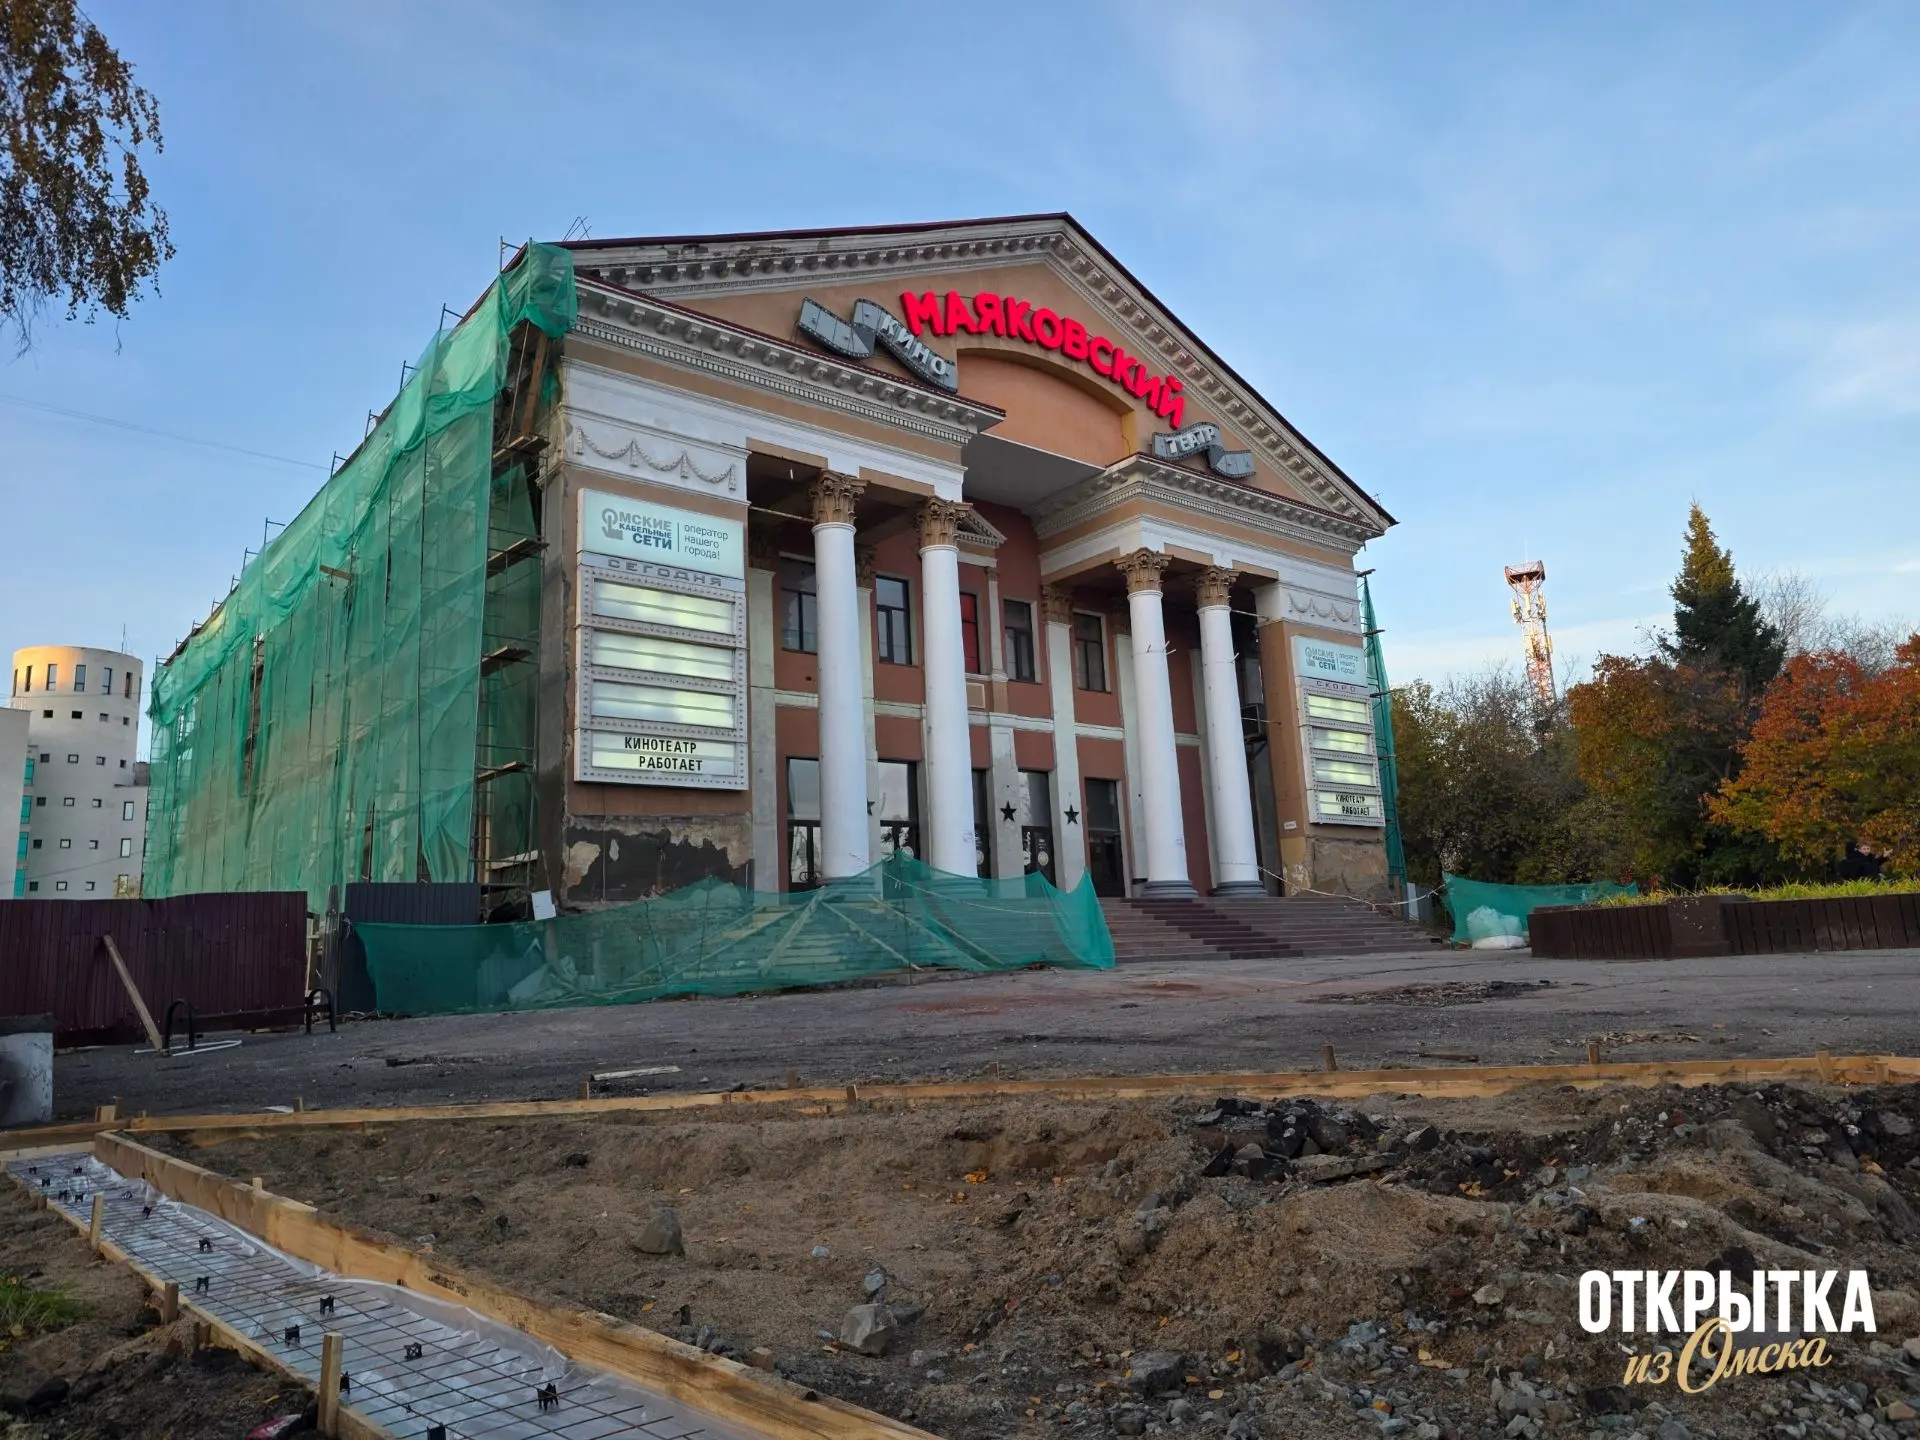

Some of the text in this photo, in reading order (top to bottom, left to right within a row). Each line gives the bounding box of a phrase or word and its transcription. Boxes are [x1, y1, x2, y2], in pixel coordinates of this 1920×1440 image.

[880, 314, 948, 376] КИНО
[900, 290, 1187, 430] МАЯКОВСКИЙ
[1165, 426, 1216, 454] ТЕАТР
[619, 523, 672, 538] КАБЕЛЬНЫЕ
[684, 524, 729, 540] оператор
[632, 533, 672, 550] СЕТИ
[684, 535, 720, 549] нашего
[684, 545, 720, 560] города!
[608, 559, 722, 586] СЕГОДНЯ
[1316, 680, 1356, 693] СКОРО
[624, 736, 697, 753] КИНОТЕАТР
[639, 755, 702, 771] РАБОТАЕТ
[1335, 794, 1366, 804] КИНОТЕАТР
[1341, 805, 1370, 816] РАБОТАЕТ
